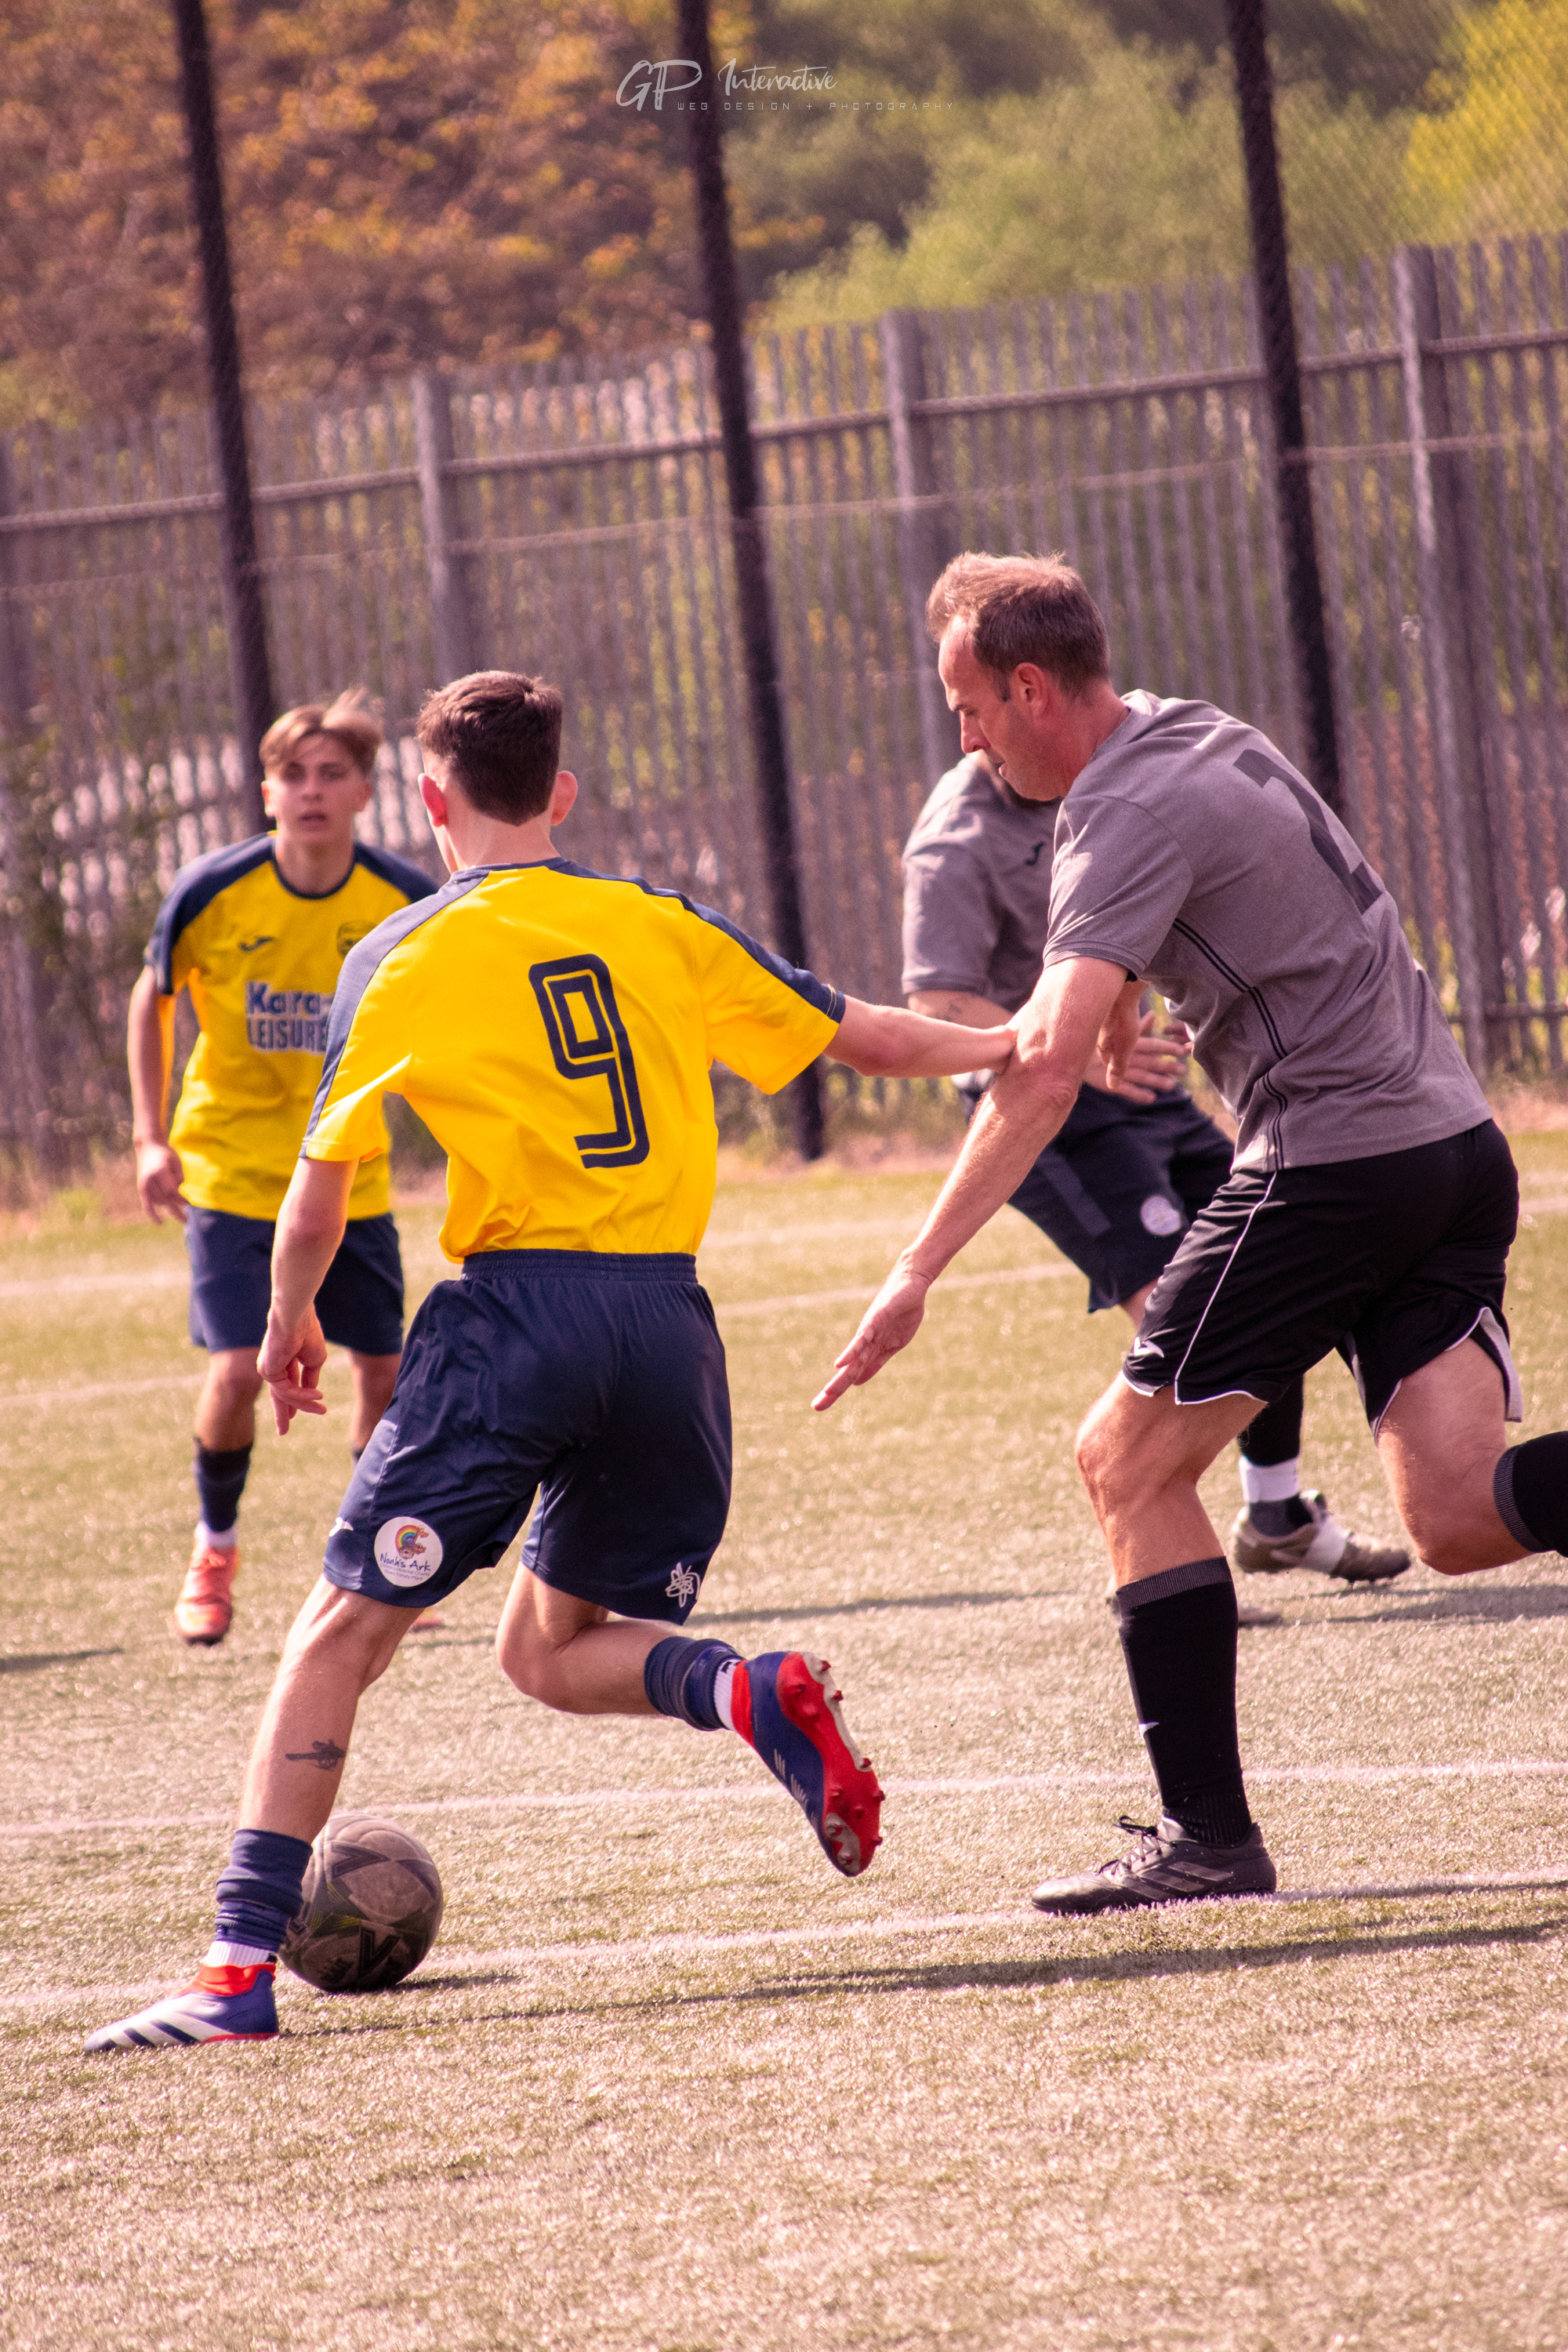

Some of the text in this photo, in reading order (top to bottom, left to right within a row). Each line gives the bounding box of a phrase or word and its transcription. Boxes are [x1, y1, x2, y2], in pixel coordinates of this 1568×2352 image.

[246, 981, 334, 1016] Kara
[528, 953, 650, 1169] 9
[380, 1552, 405, 1568] Noah's
[409, 1560, 431, 1571] Ark
